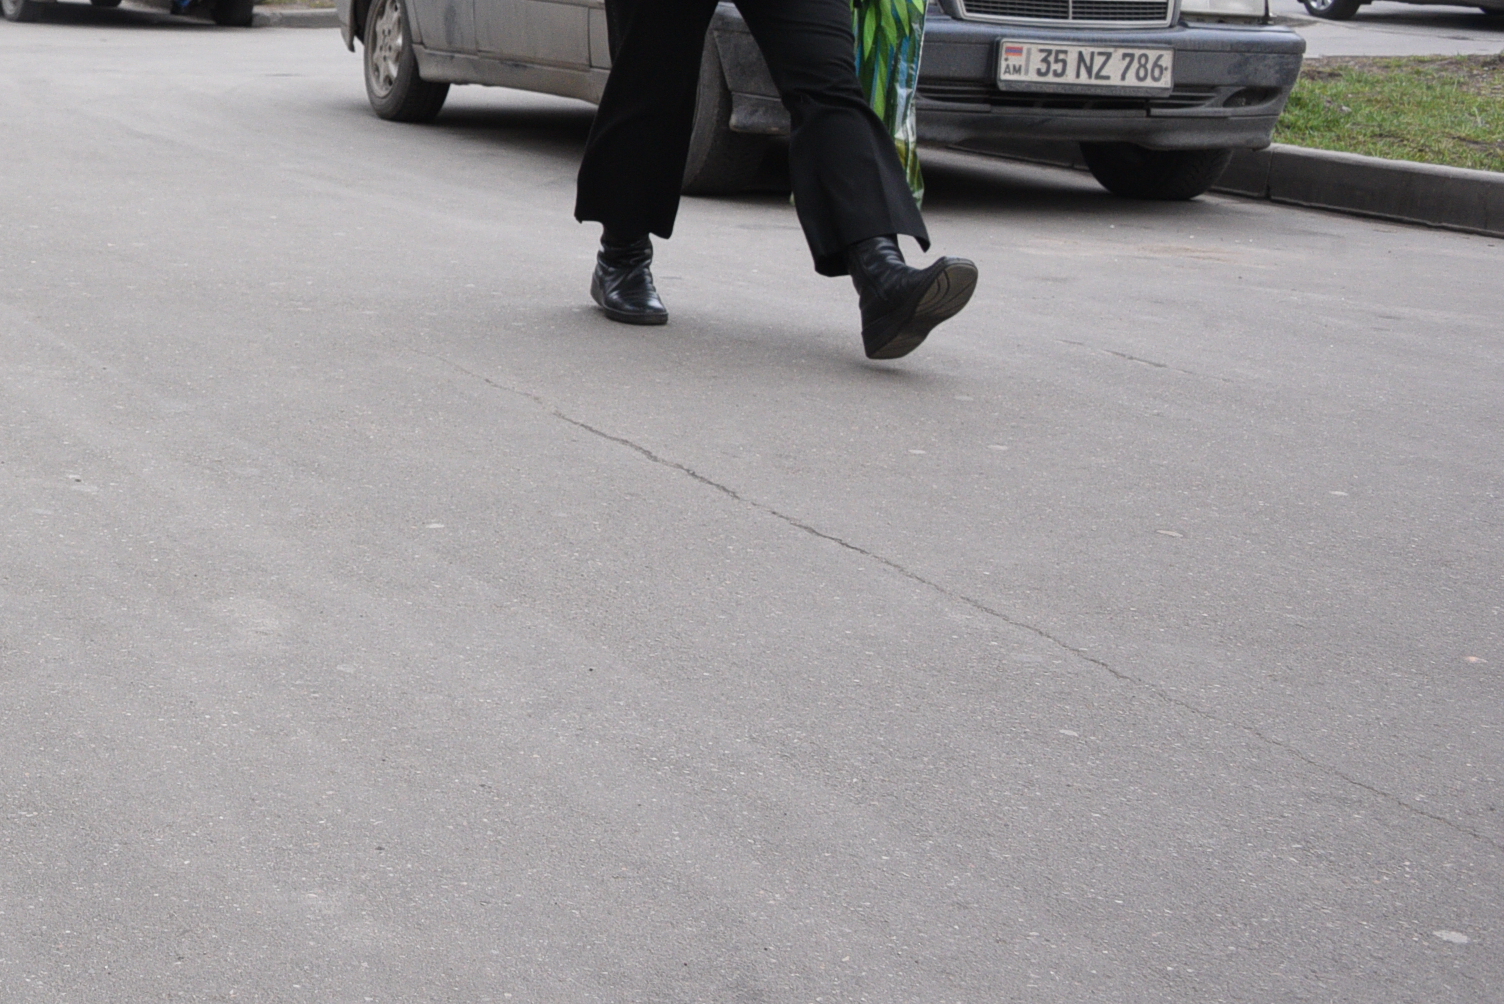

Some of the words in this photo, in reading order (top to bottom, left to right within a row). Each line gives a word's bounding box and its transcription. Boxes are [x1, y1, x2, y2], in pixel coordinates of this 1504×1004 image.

[1003, 64, 1022, 76] AM
[1036, 48, 1068, 78] 35
[1075, 50, 1113, 81] NZ
[1120, 52, 1164, 82] 786
